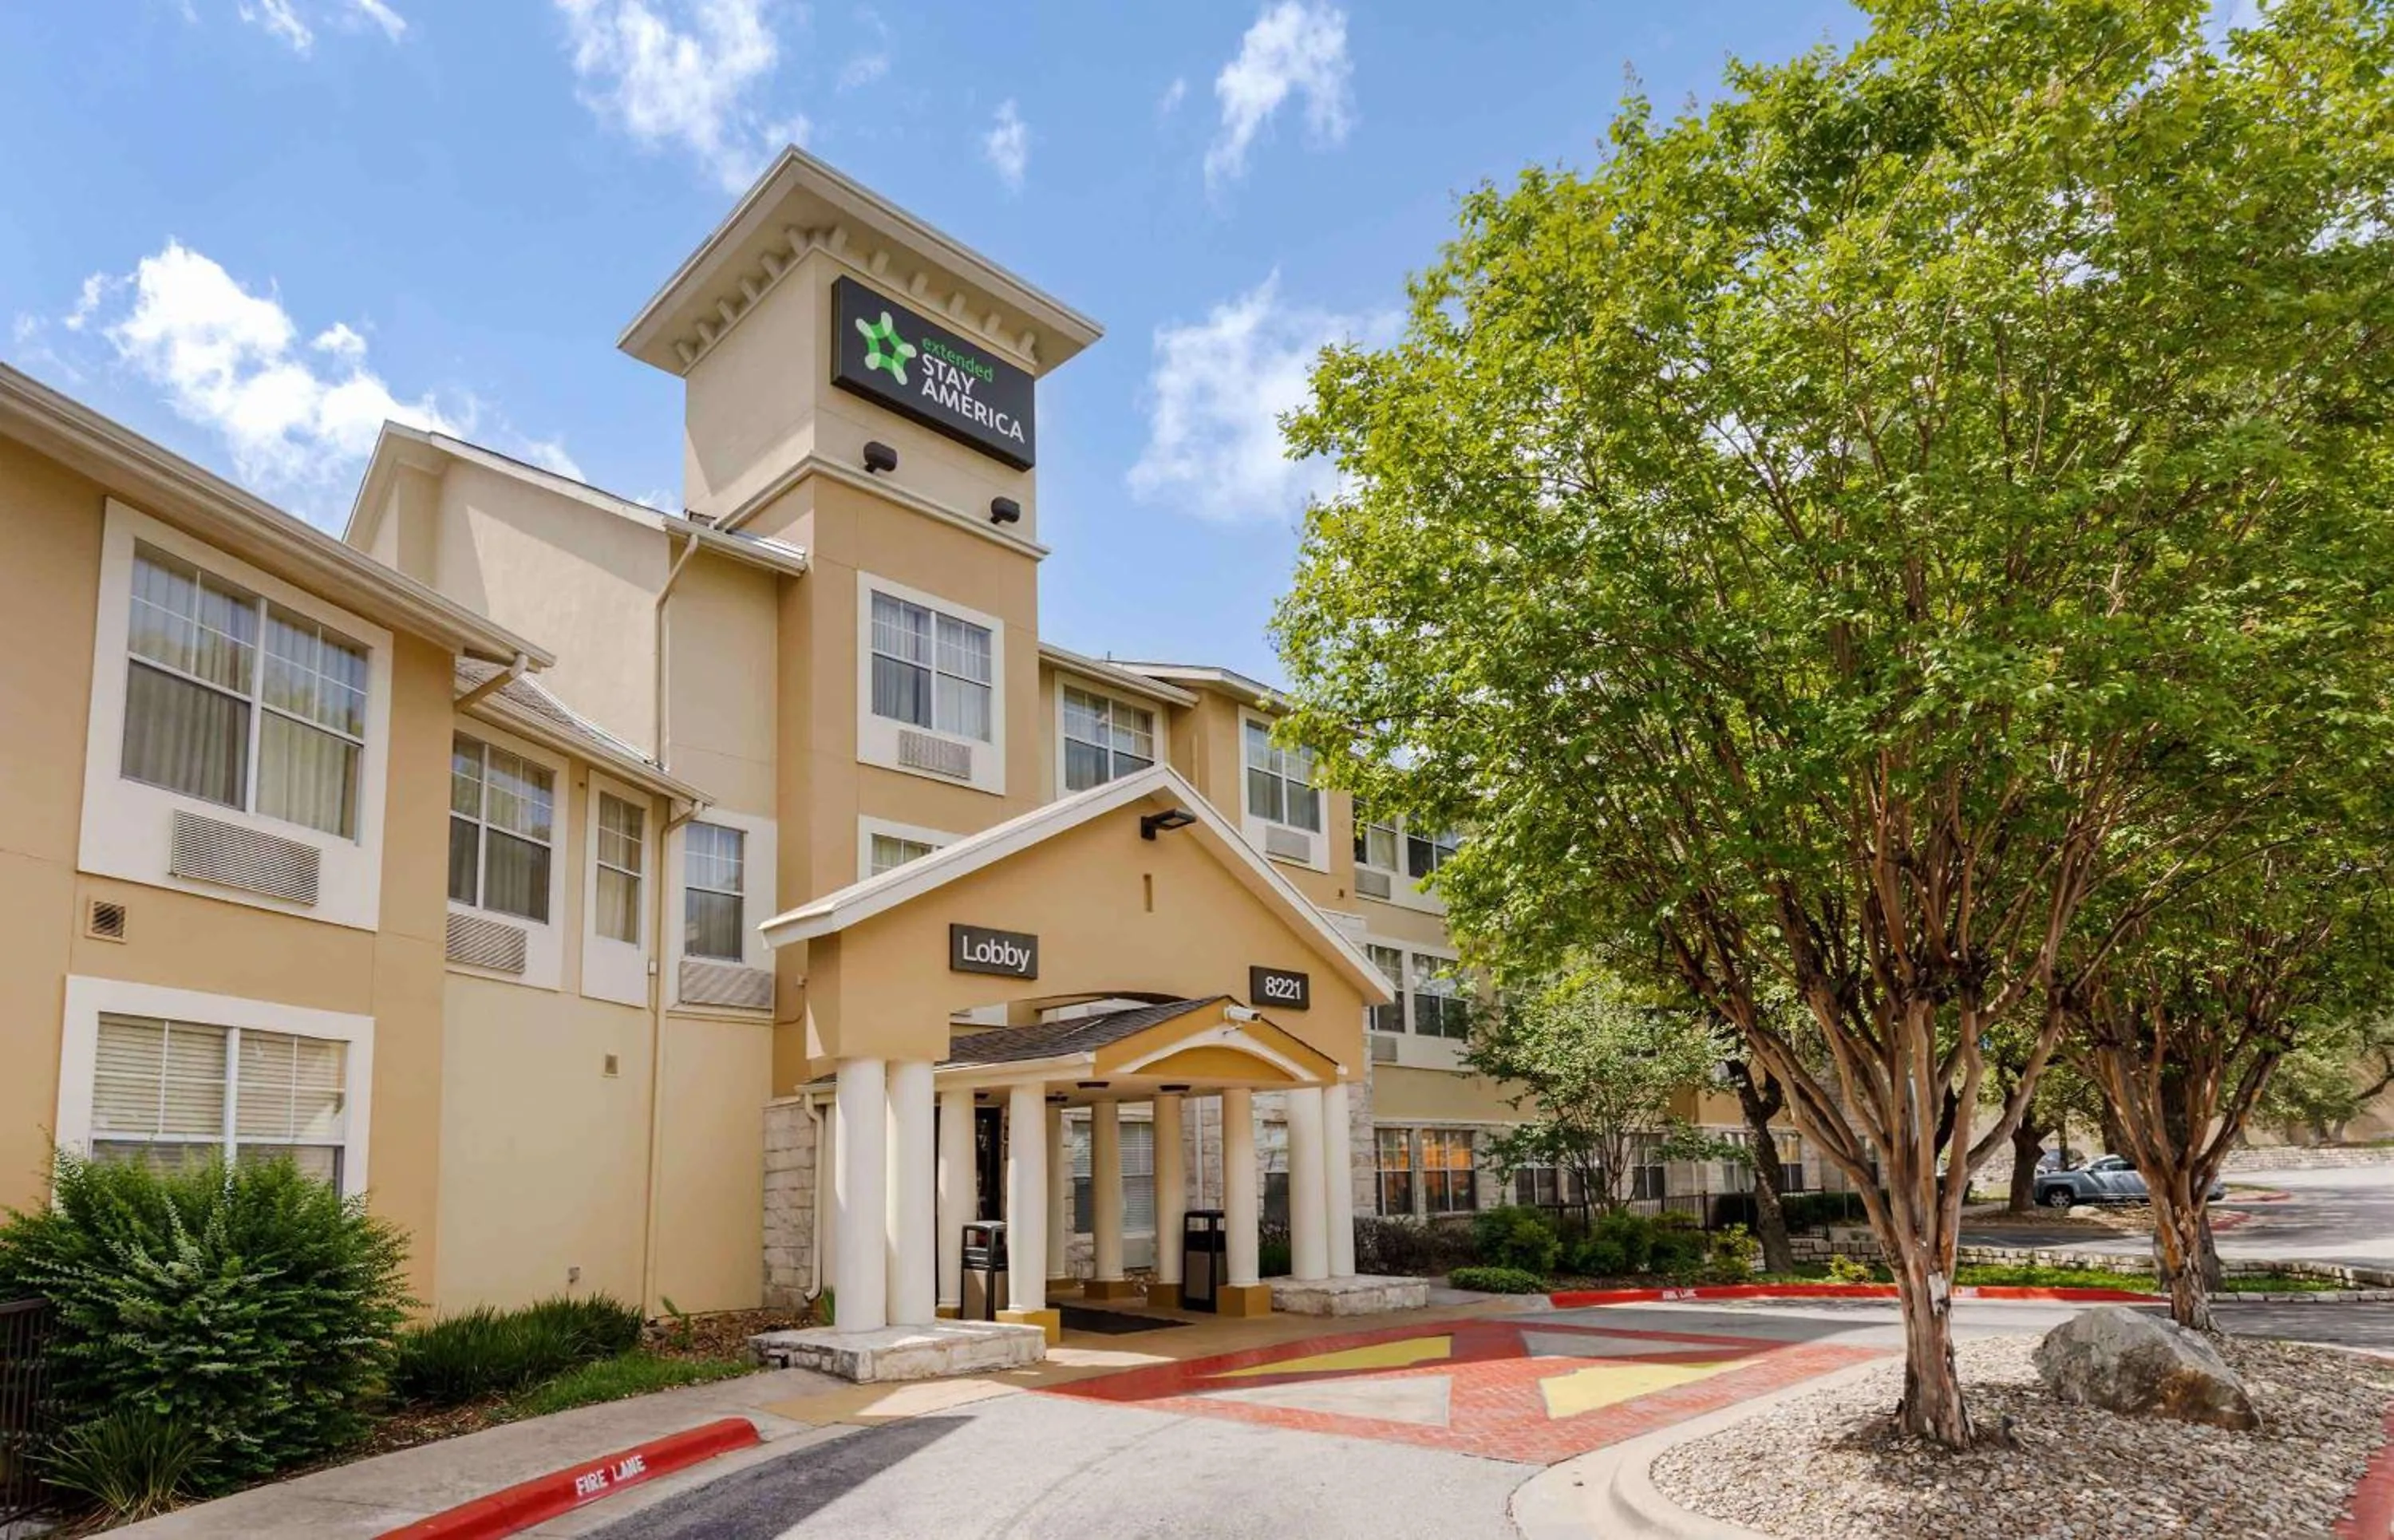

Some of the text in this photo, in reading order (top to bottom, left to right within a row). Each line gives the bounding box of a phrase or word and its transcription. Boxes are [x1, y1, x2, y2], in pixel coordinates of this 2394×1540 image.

[922, 338, 994, 382] extended
[922, 353, 975, 394] STAY
[922, 378, 1025, 444] AMERICA
[962, 935, 1030, 972] Lobby
[1265, 976, 1301, 1000] 8221
[575, 1455, 646, 1496] FIRE LANE
